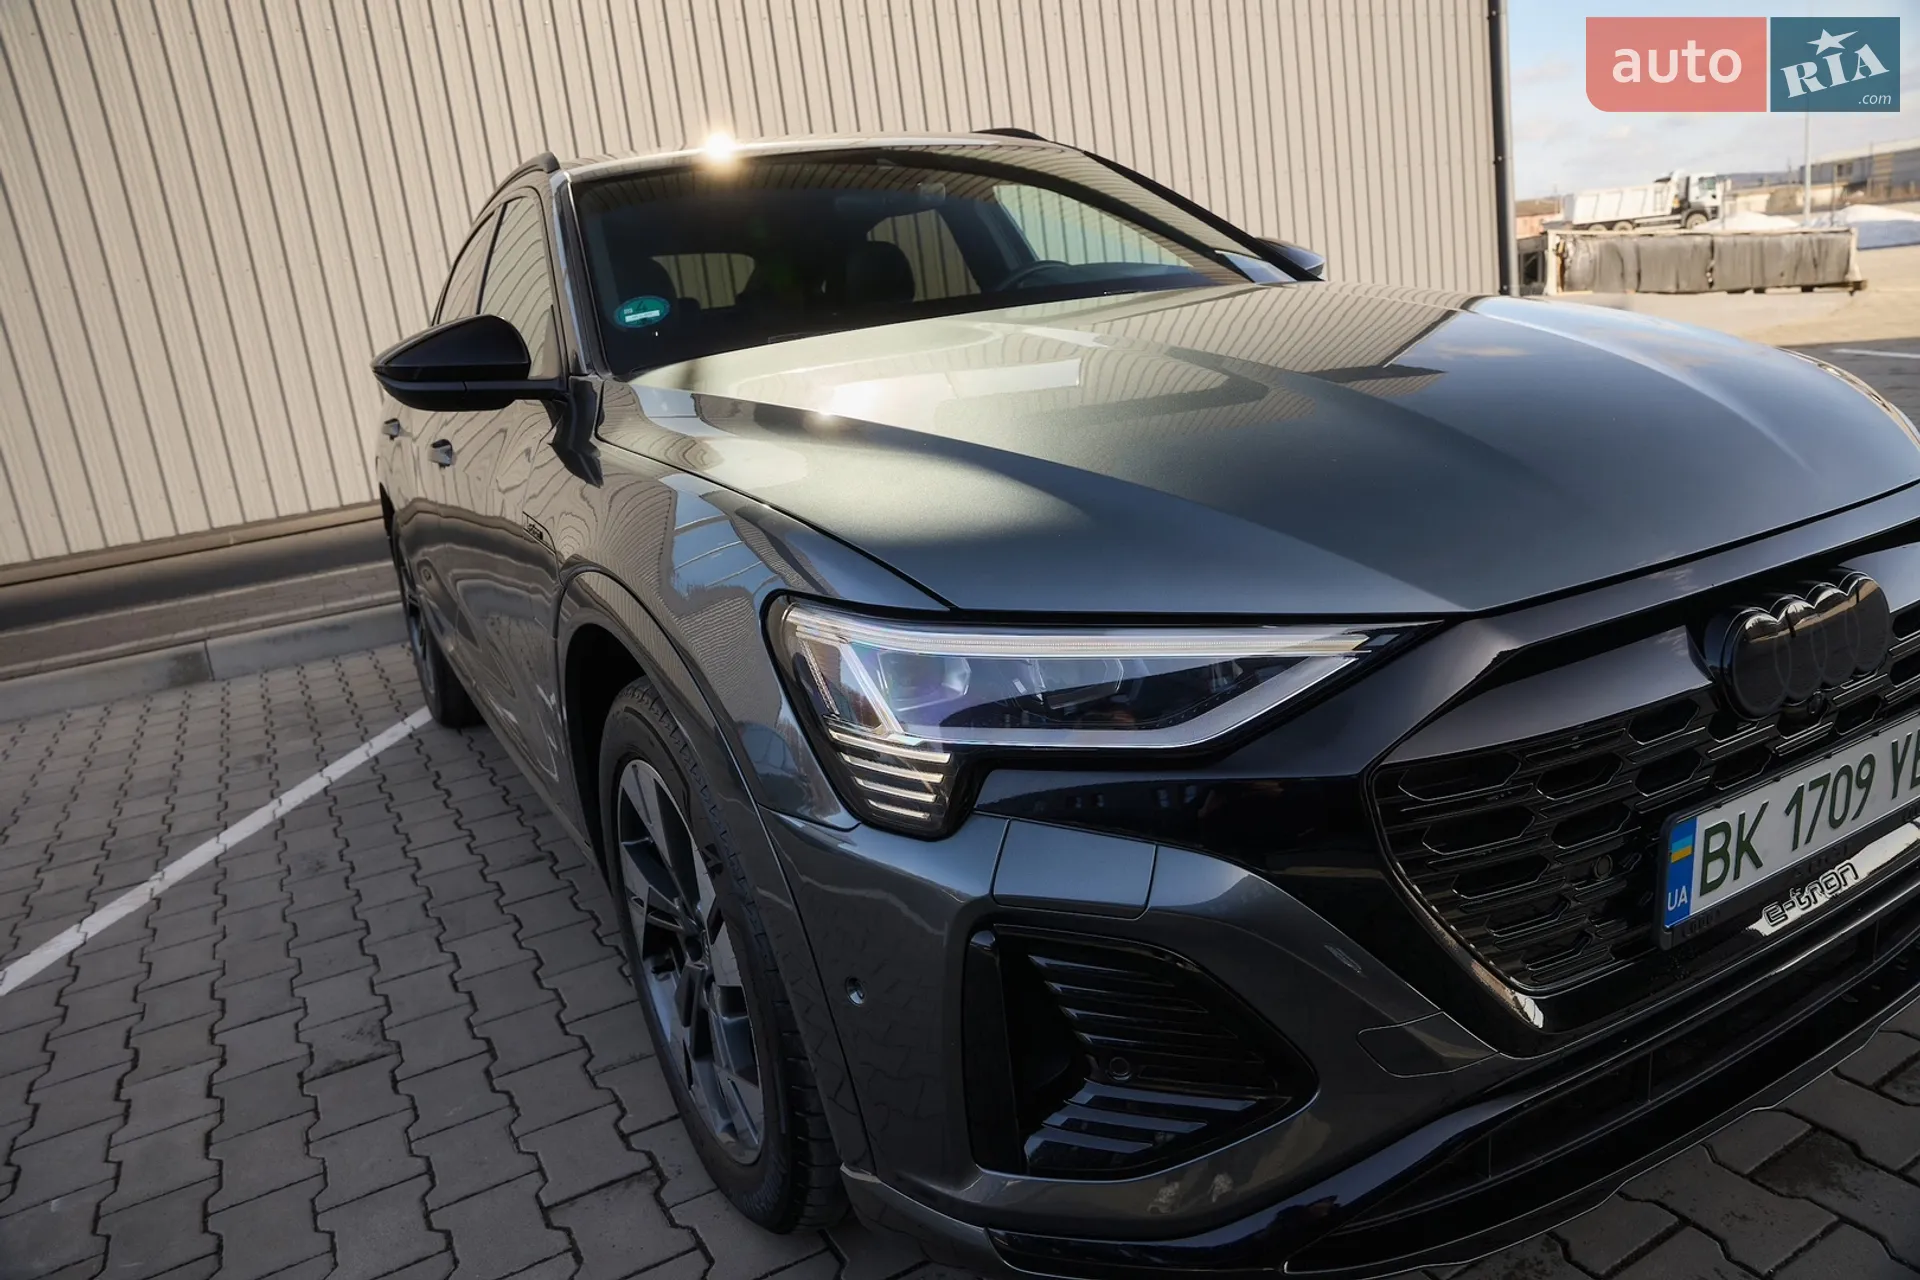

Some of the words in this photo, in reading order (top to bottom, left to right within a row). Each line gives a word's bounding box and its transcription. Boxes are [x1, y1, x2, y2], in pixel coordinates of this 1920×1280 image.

[1699, 800, 1769, 898] BK
[1784, 753, 1876, 852] 1709
[1667, 885, 1688, 911] UA
[1763, 859, 1860, 928] e-tron
